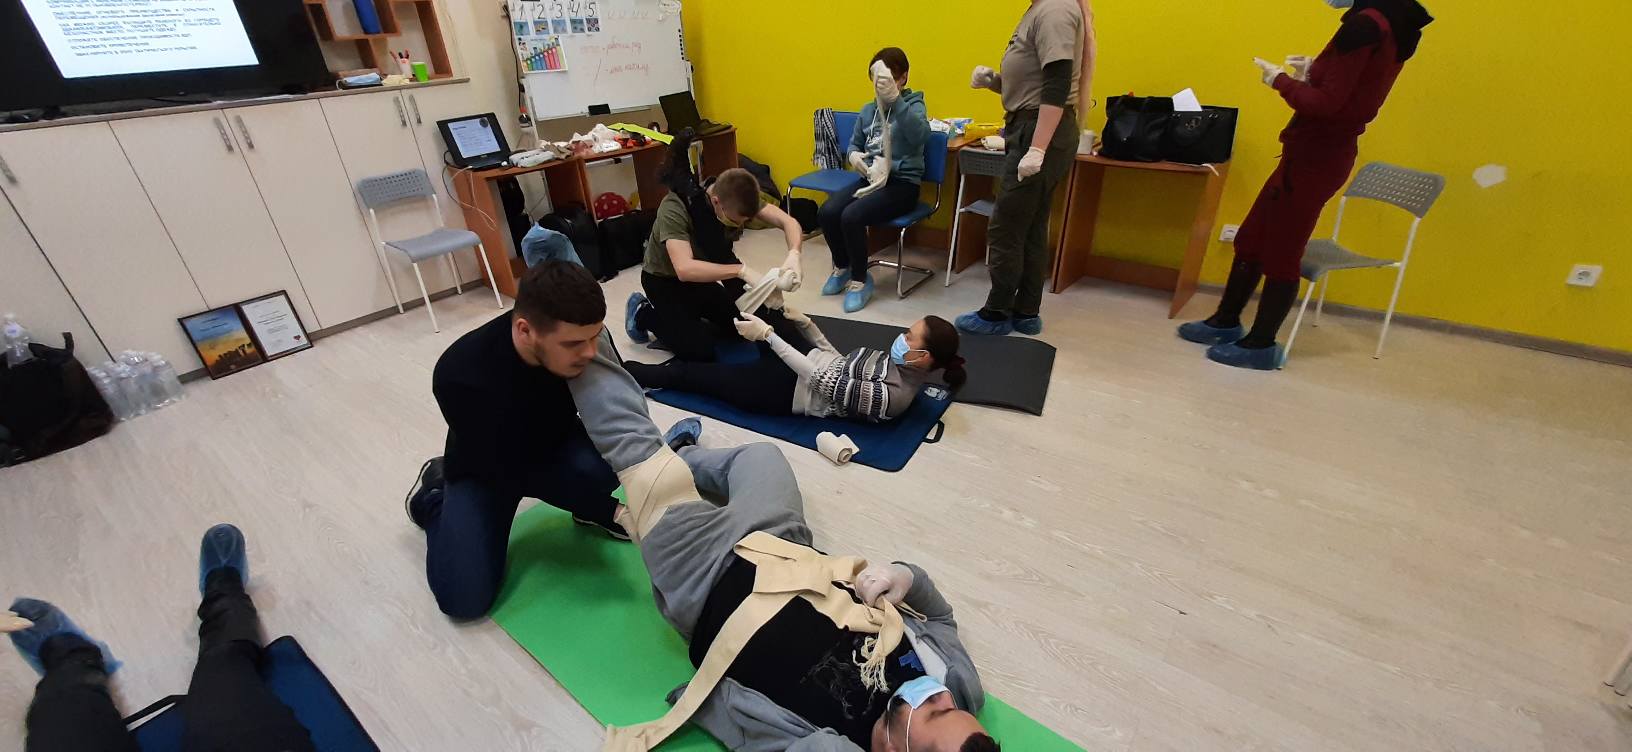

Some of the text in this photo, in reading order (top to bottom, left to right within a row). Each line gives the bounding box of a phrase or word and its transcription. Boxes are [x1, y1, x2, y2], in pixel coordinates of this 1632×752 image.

[535, 3, 546, 20] 2
[555, 3, 563, 19] 3
[571, 2, 581, 18] 4
[588, 2, 596, 17] 5
